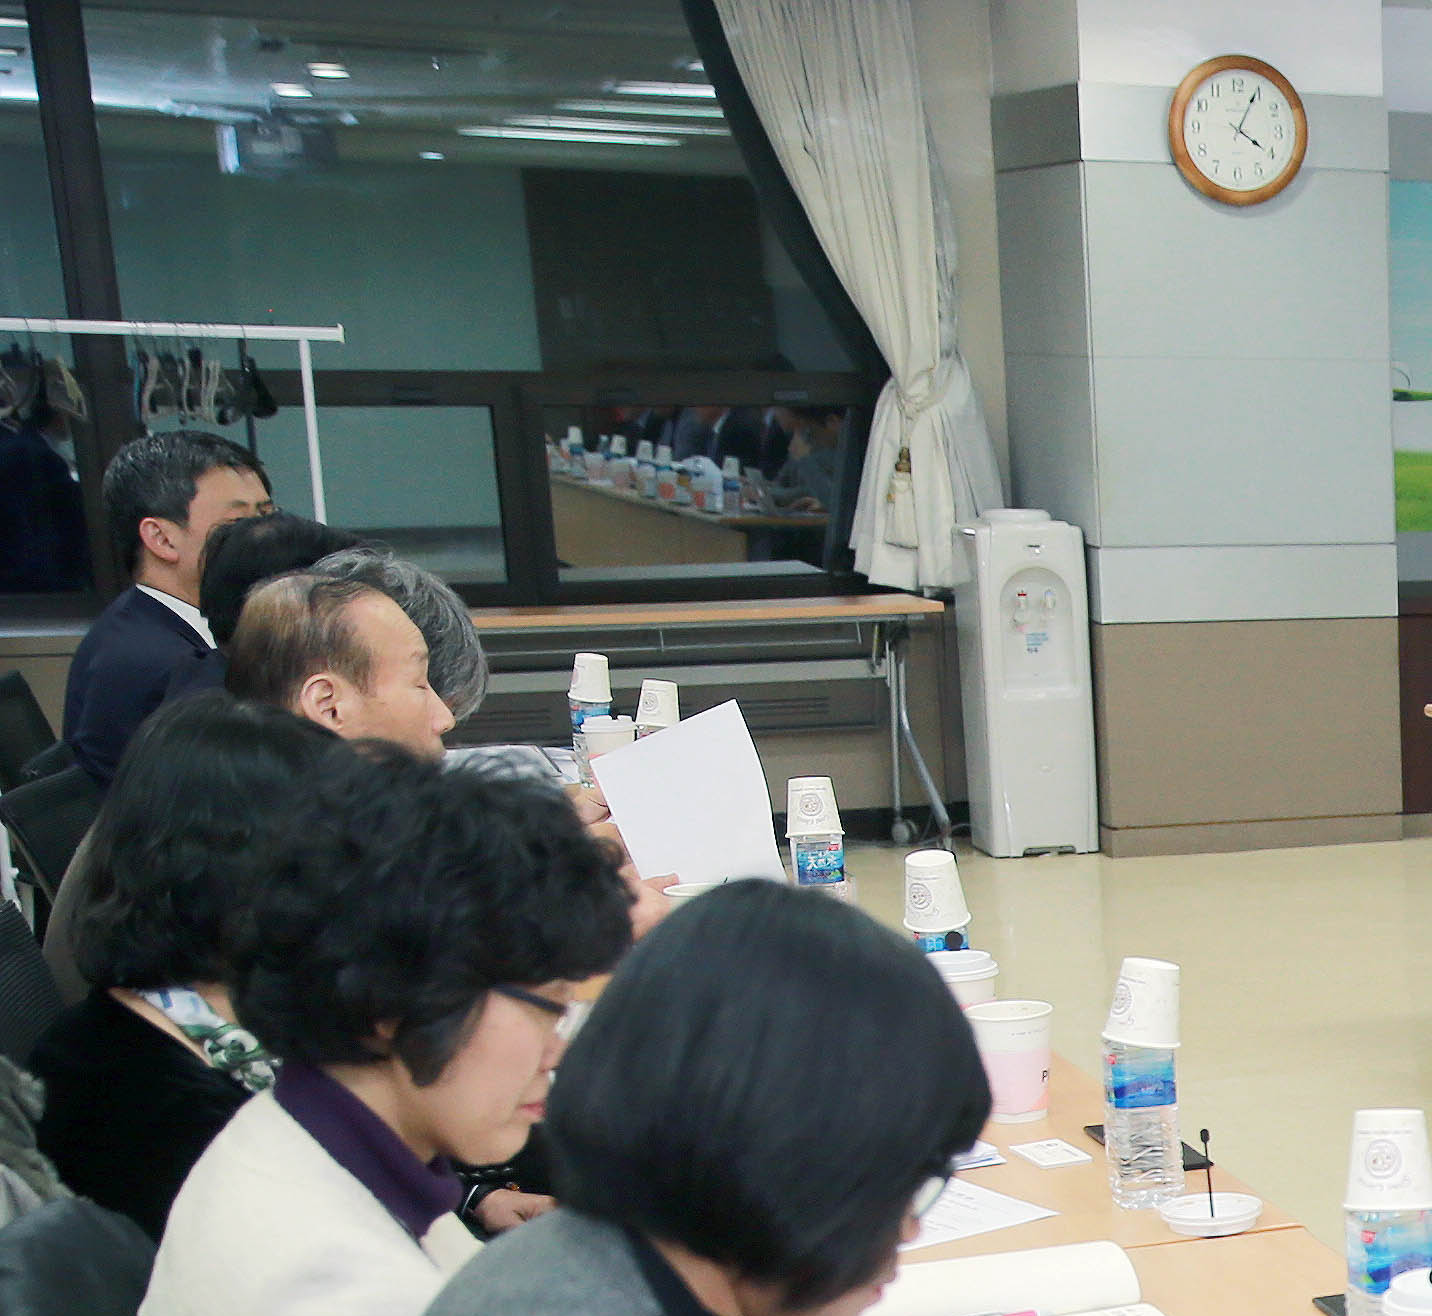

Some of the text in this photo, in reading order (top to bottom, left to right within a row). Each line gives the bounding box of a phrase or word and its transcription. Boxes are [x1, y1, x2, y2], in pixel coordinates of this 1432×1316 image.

[1211, 82, 1221, 98] 11
[1232, 78, 1244, 93] 12
[1197, 99, 1208, 113] 10
[1268, 103, 1279, 118] 2
[1191, 121, 1201, 134] 9
[1274, 124, 1284, 140] 3
[1197, 143, 1207, 157] 8
[1212, 159, 1220, 174] 7
[1233, 167, 1243, 181] 6
[1254, 162, 1263, 177] 5
